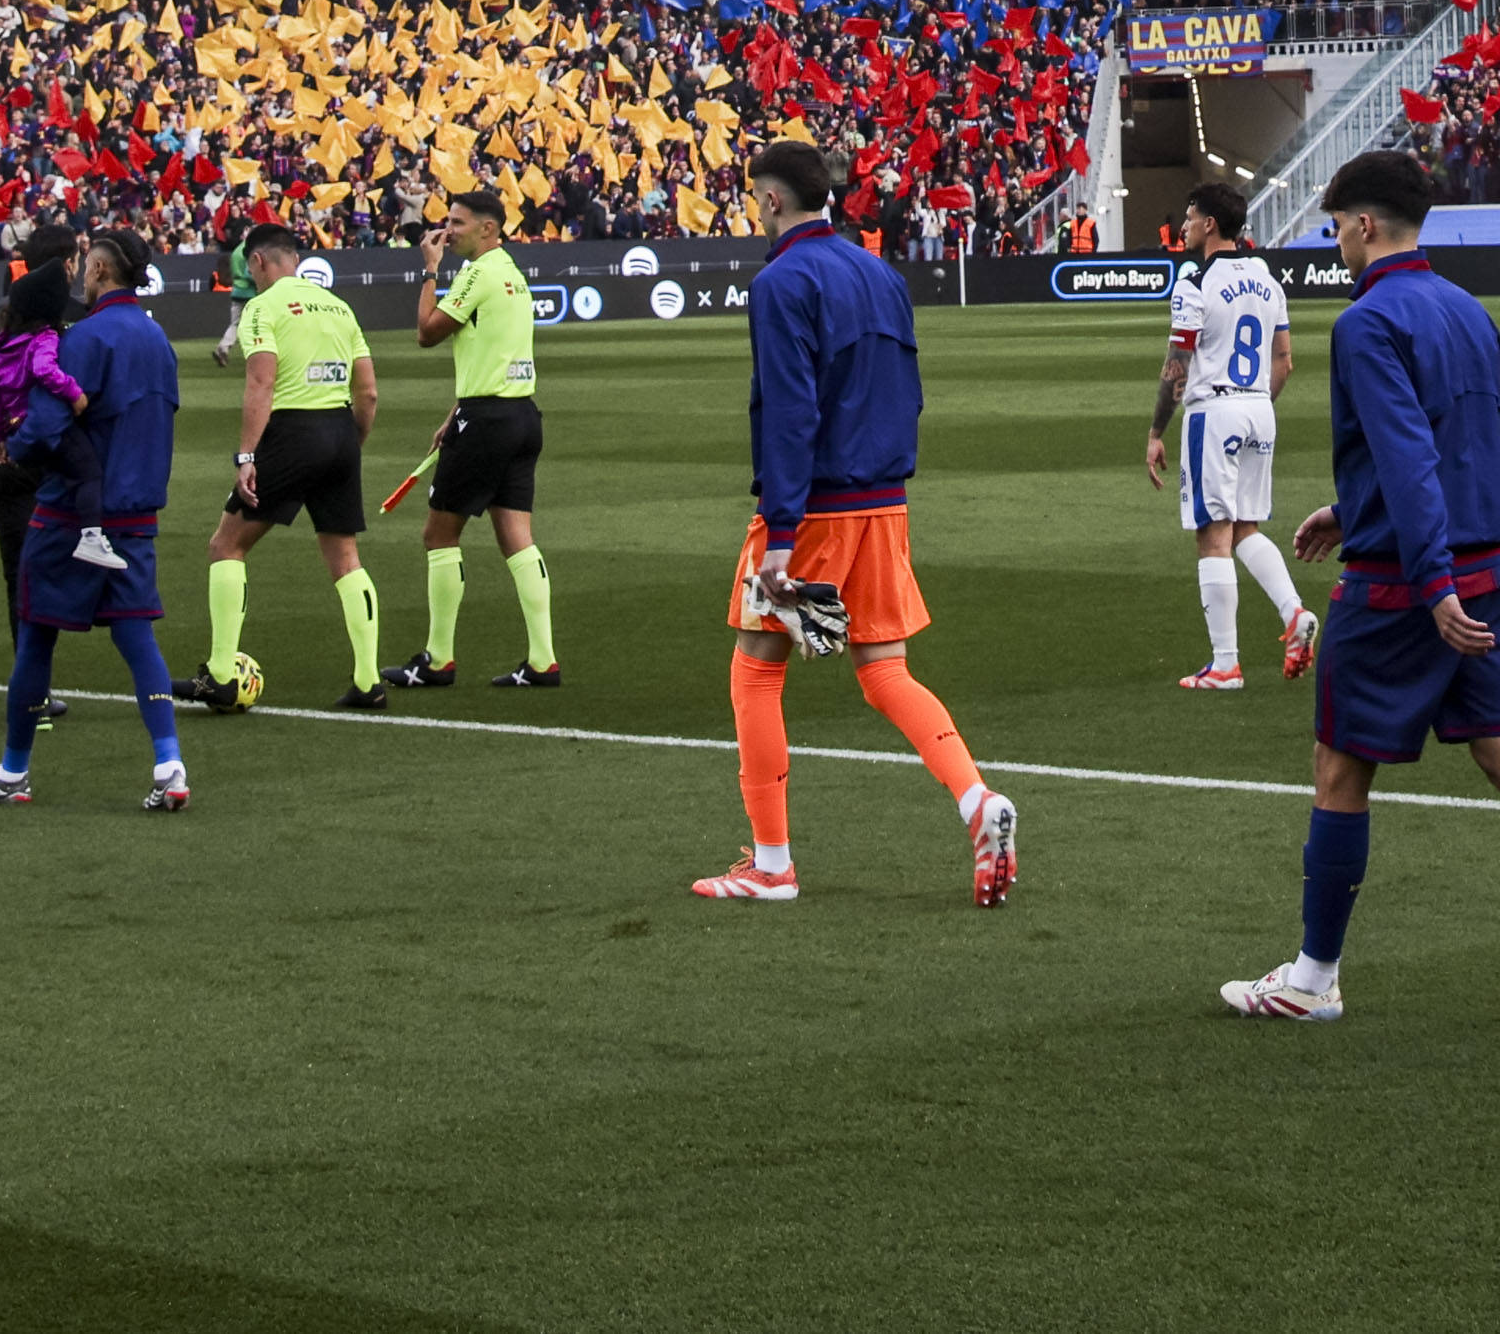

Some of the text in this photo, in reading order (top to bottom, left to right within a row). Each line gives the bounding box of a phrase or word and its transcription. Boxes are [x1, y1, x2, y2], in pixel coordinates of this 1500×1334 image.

[1132, 14, 1262, 50] LA CAVA
[1166, 46, 1231, 63] GALATXO
[1073, 270, 1164, 290] play the Barça
[1304, 263, 1354, 285] Andro
[1220, 280, 1272, 304] BLANCO
[1228, 314, 1262, 387] 8
